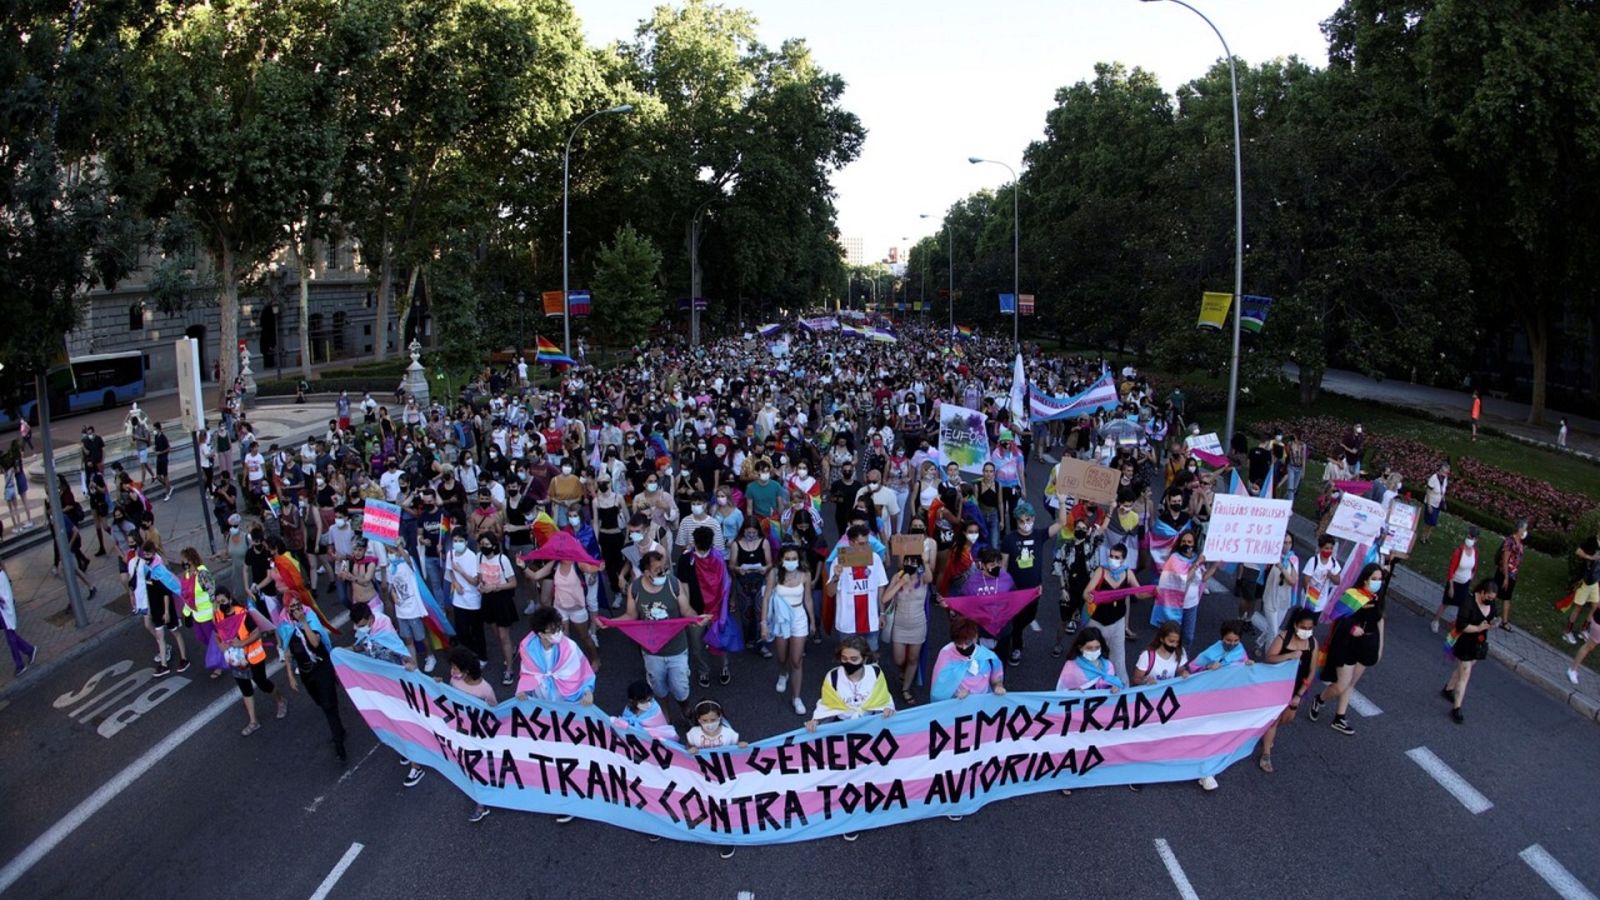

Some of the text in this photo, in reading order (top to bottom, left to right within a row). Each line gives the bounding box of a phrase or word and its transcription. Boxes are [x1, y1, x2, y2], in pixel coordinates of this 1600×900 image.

[1224, 522, 1273, 535] DE SUS
[1245, 538, 1279, 555] TRANS
[400, 679, 1180, 785] NI SEXO ASIGNADO NI GÉNERO DEMOSTRADO
[529, 752, 649, 810] TRANS
[658, 781, 809, 834] CONTRA
[817, 779, 908, 820] TODA
